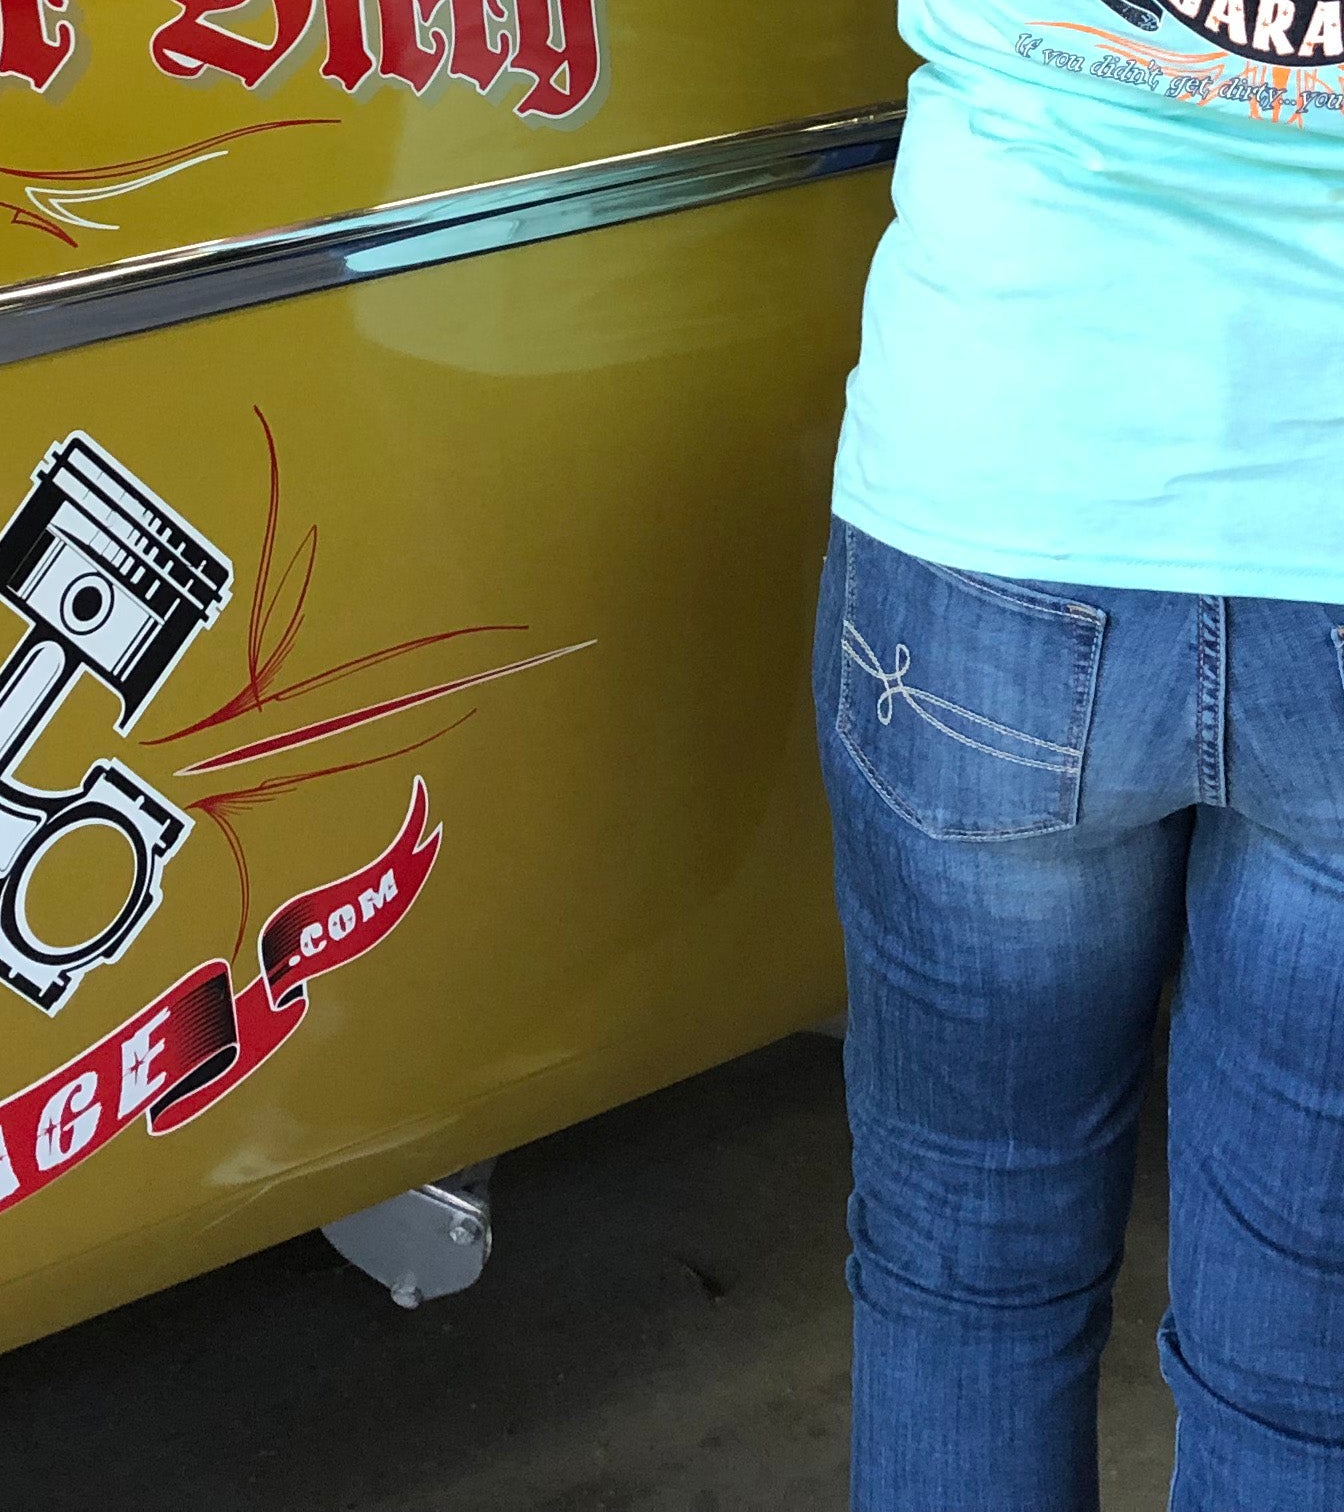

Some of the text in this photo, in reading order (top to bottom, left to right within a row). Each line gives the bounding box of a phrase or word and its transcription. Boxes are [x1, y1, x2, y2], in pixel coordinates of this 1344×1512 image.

[1014, 32, 1041, 59] If
[1042, 46, 1085, 73] you
[1089, 53, 1164, 92] didn't
[1164, 74, 1214, 100] get
